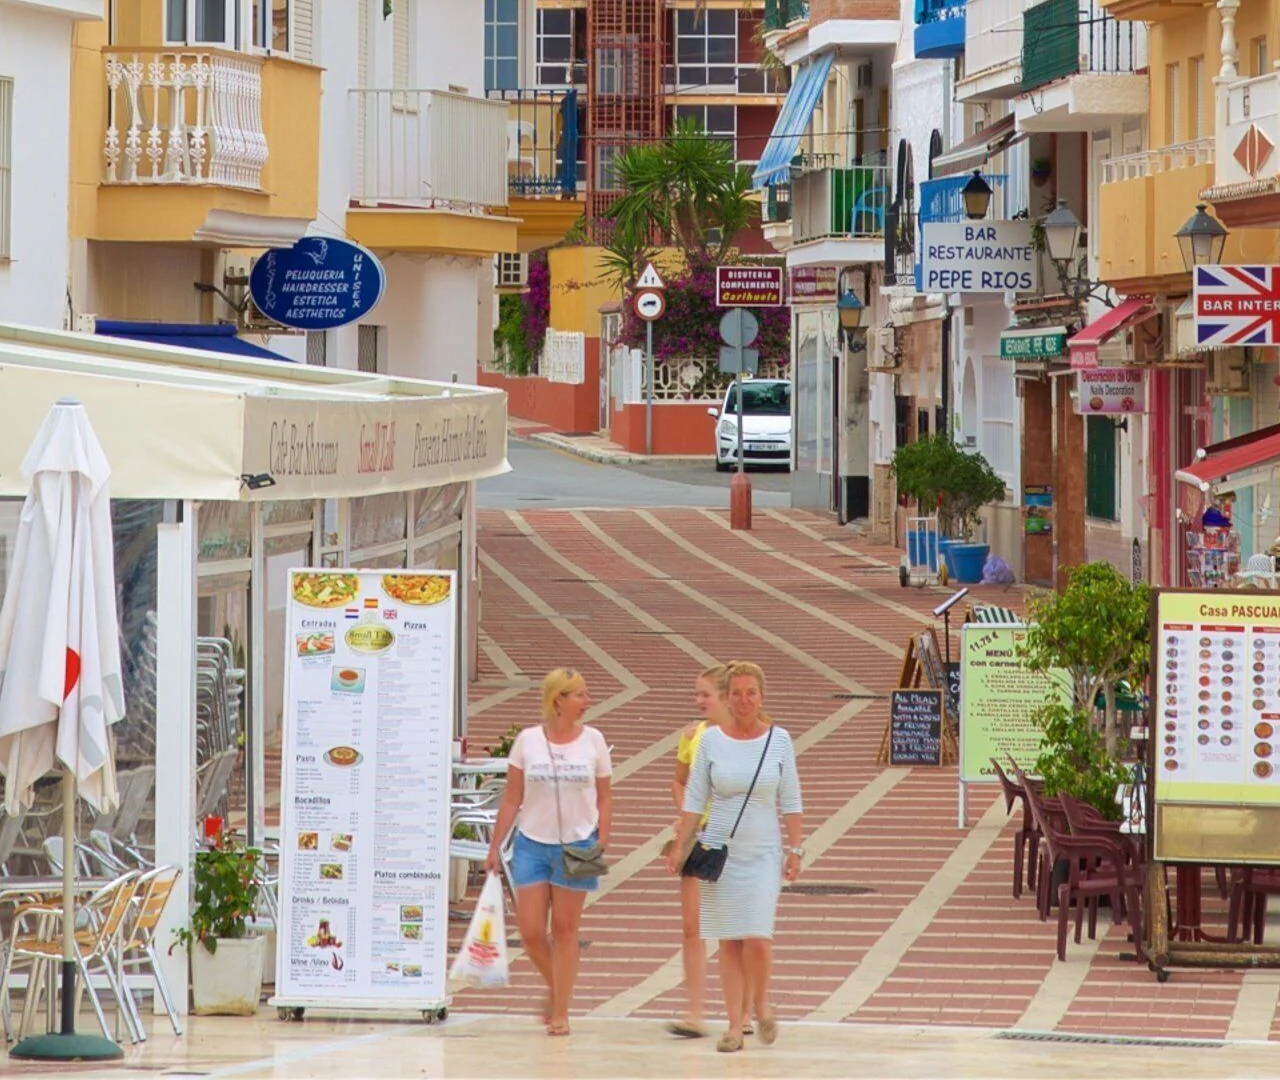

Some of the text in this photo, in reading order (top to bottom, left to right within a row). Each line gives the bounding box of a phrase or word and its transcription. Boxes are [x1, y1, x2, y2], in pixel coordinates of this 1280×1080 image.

[965, 227, 997, 242] BAR
[928, 246, 1033, 262] RESTAURANTE
[285, 269, 345, 280] PELUQUERIA
[728, 271, 772, 279] BISUTERIA
[928, 270, 1033, 289] PEPE RIOS
[352, 253, 363, 309] UNISEX
[720, 281, 779, 289] COMPLEMENTOS
[282, 282, 349, 293] HAIRDRESSER
[293, 295, 337, 306] ESTETICA
[1203, 300, 1233, 311] BAR
[285, 308, 346, 319] AESTHETICS
[1105, 385, 1135, 395] Decoration
[1200, 605, 1228, 617] Casa
[301, 620, 427, 631] Entradas Pizzas
[969, 635, 993, 652] 11.75
[985, 648, 1013, 657] MENÚ
[296, 754, 316, 763] Pasta
[294, 796, 331, 805] Bocadillos
[374, 871, 441, 880] Platos combinados
[292, 896, 314, 905] Drinks
[322, 896, 350, 905] Bebidas
[290, 958, 308, 966] Wine
